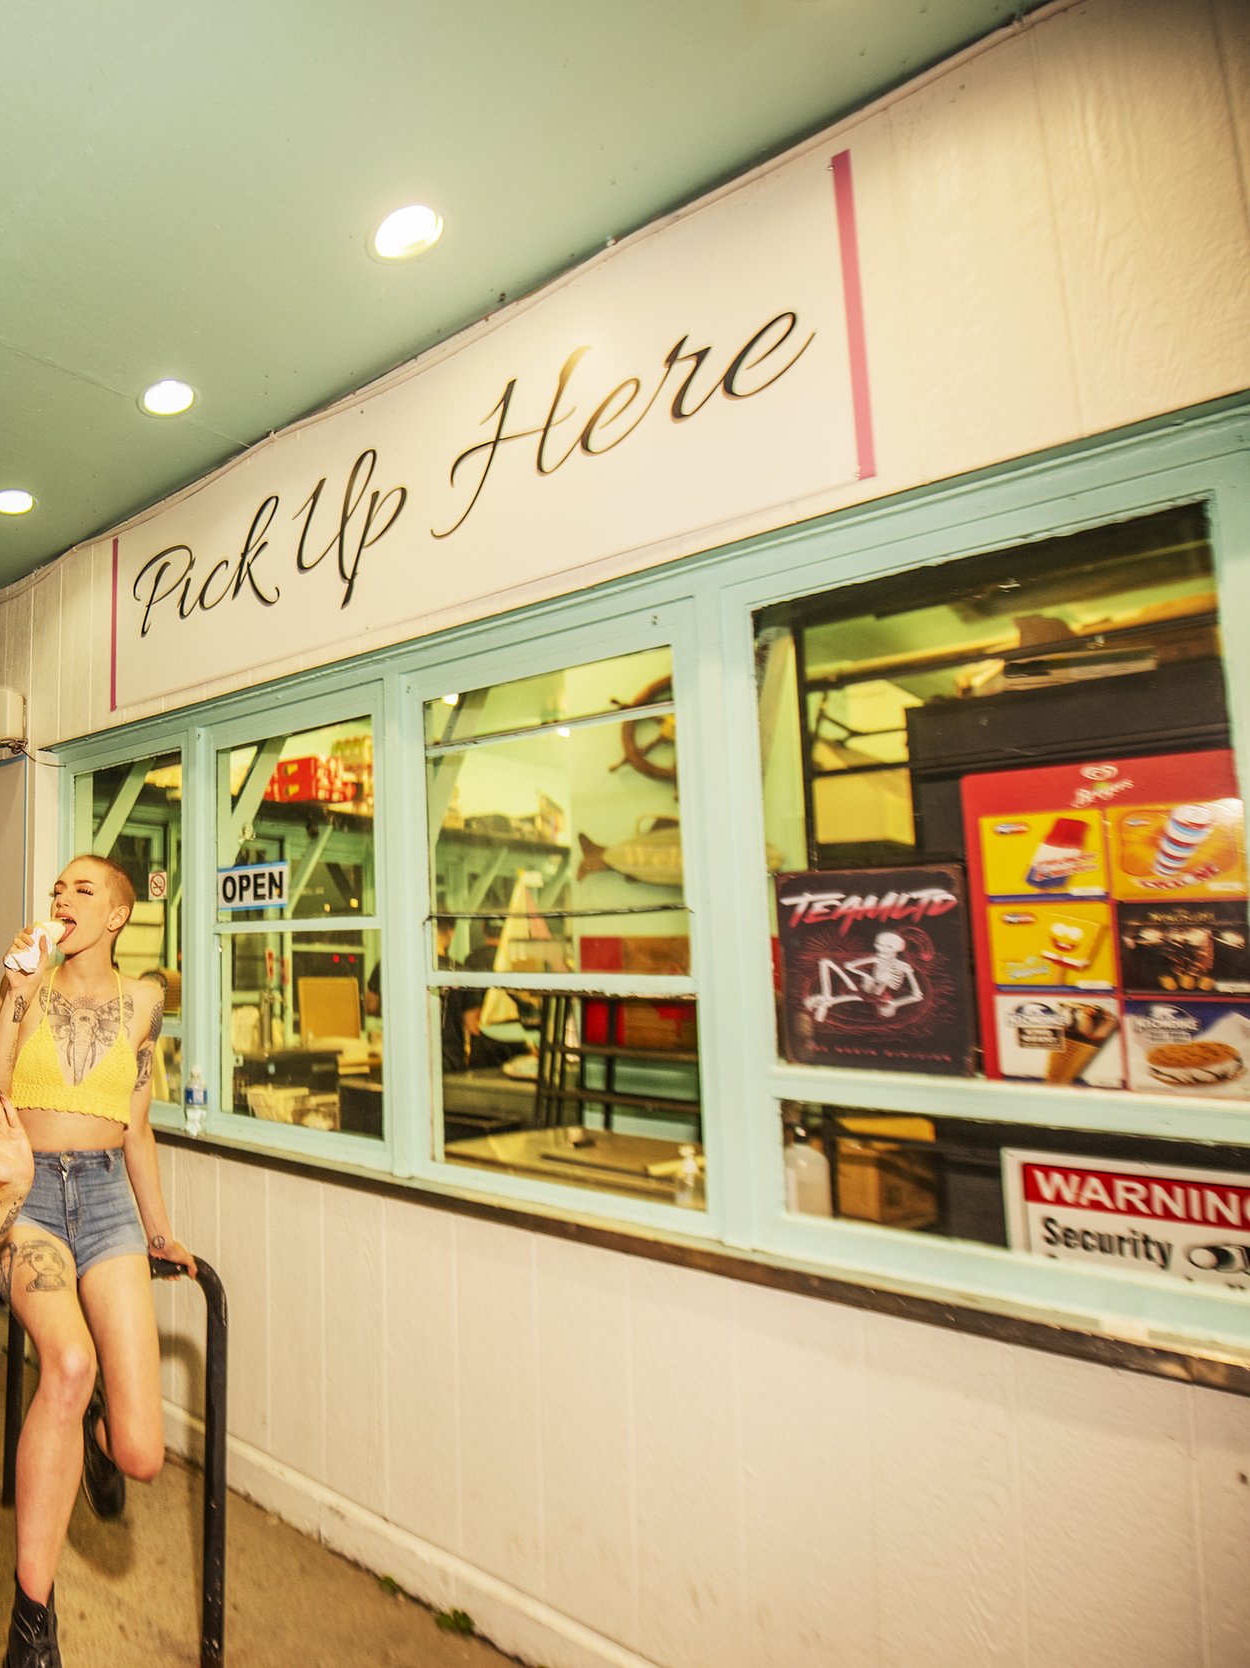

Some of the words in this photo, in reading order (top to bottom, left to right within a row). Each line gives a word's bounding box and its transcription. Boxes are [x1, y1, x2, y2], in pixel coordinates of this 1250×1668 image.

[133, 494, 280, 638] Pick
[291, 448, 408, 610] Up
[430, 310, 817, 538] Here
[222, 870, 284, 904] OPEN
[1042, 1215, 1174, 1270] Security
